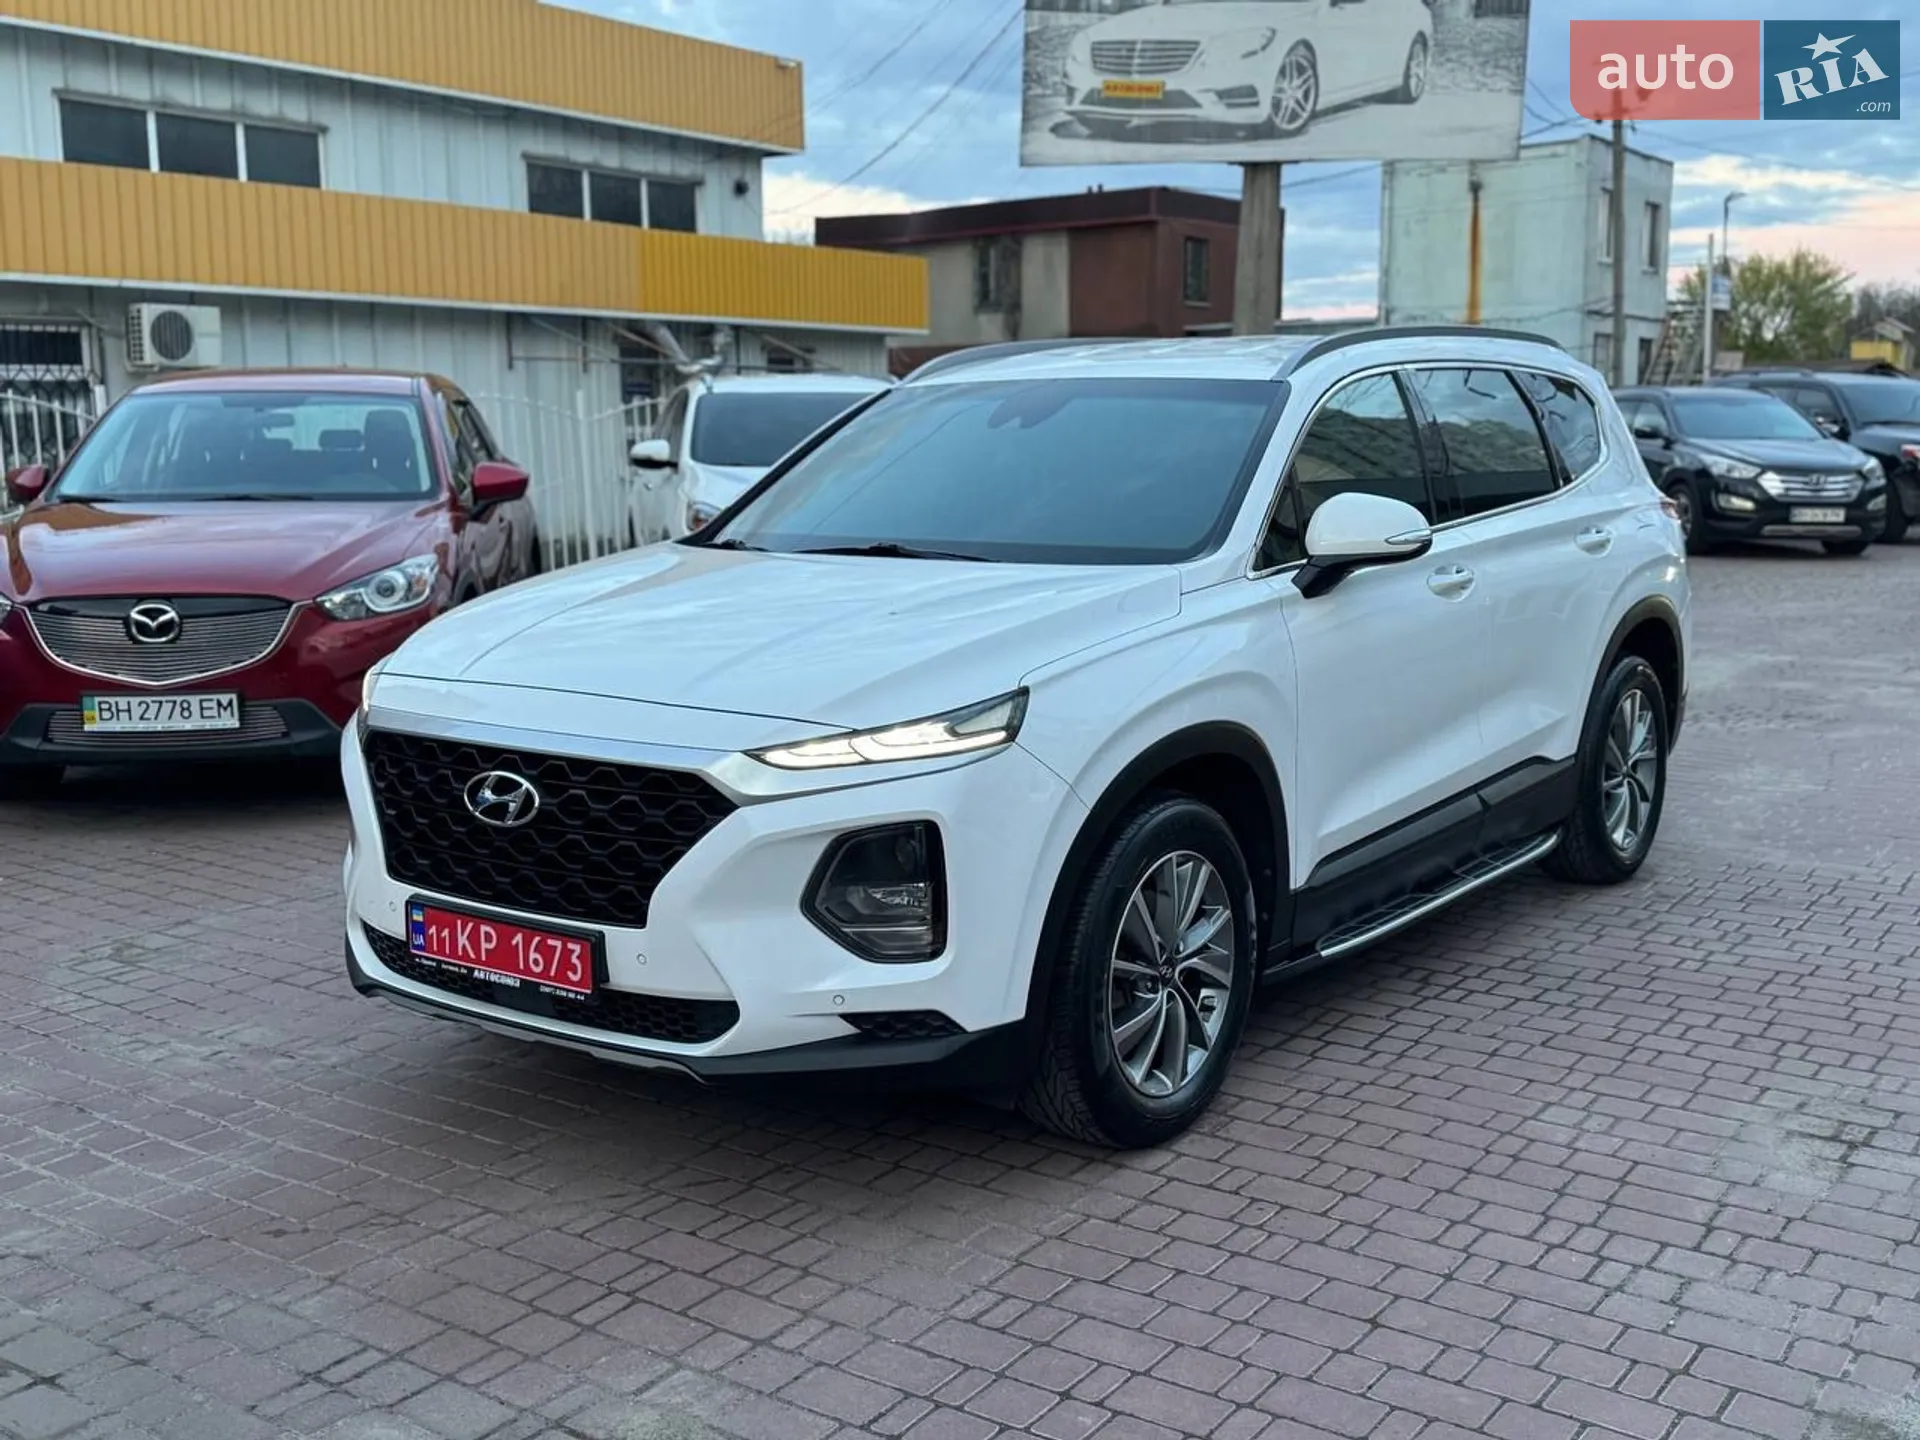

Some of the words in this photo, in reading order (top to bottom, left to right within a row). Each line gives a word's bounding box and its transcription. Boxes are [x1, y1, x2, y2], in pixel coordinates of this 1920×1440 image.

[98, 700, 132, 721] BH
[138, 700, 193, 721] 2778
[199, 697, 235, 719] EM
[412, 932, 425, 946] UA
[511, 933, 583, 982] 1673
